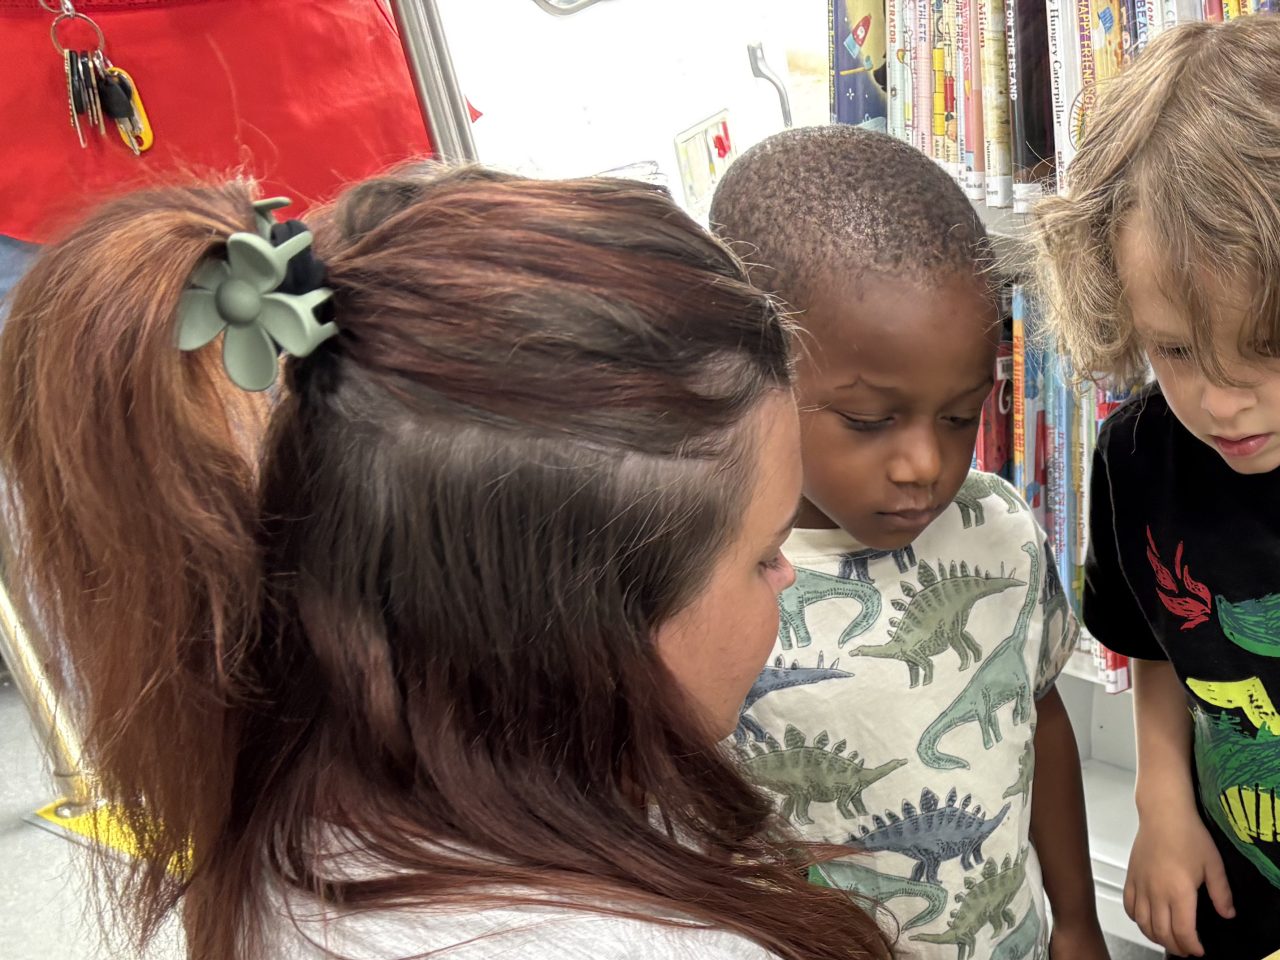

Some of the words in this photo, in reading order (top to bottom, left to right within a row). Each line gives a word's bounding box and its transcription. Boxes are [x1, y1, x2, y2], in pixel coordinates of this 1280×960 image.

[1006, 9, 1013, 25] ON
[1048, 8, 1061, 56] Hungry
[1006, 30, 1015, 54] THE
[1007, 58, 1017, 100] ISLAND
[1051, 60, 1066, 126] Caterpillar
